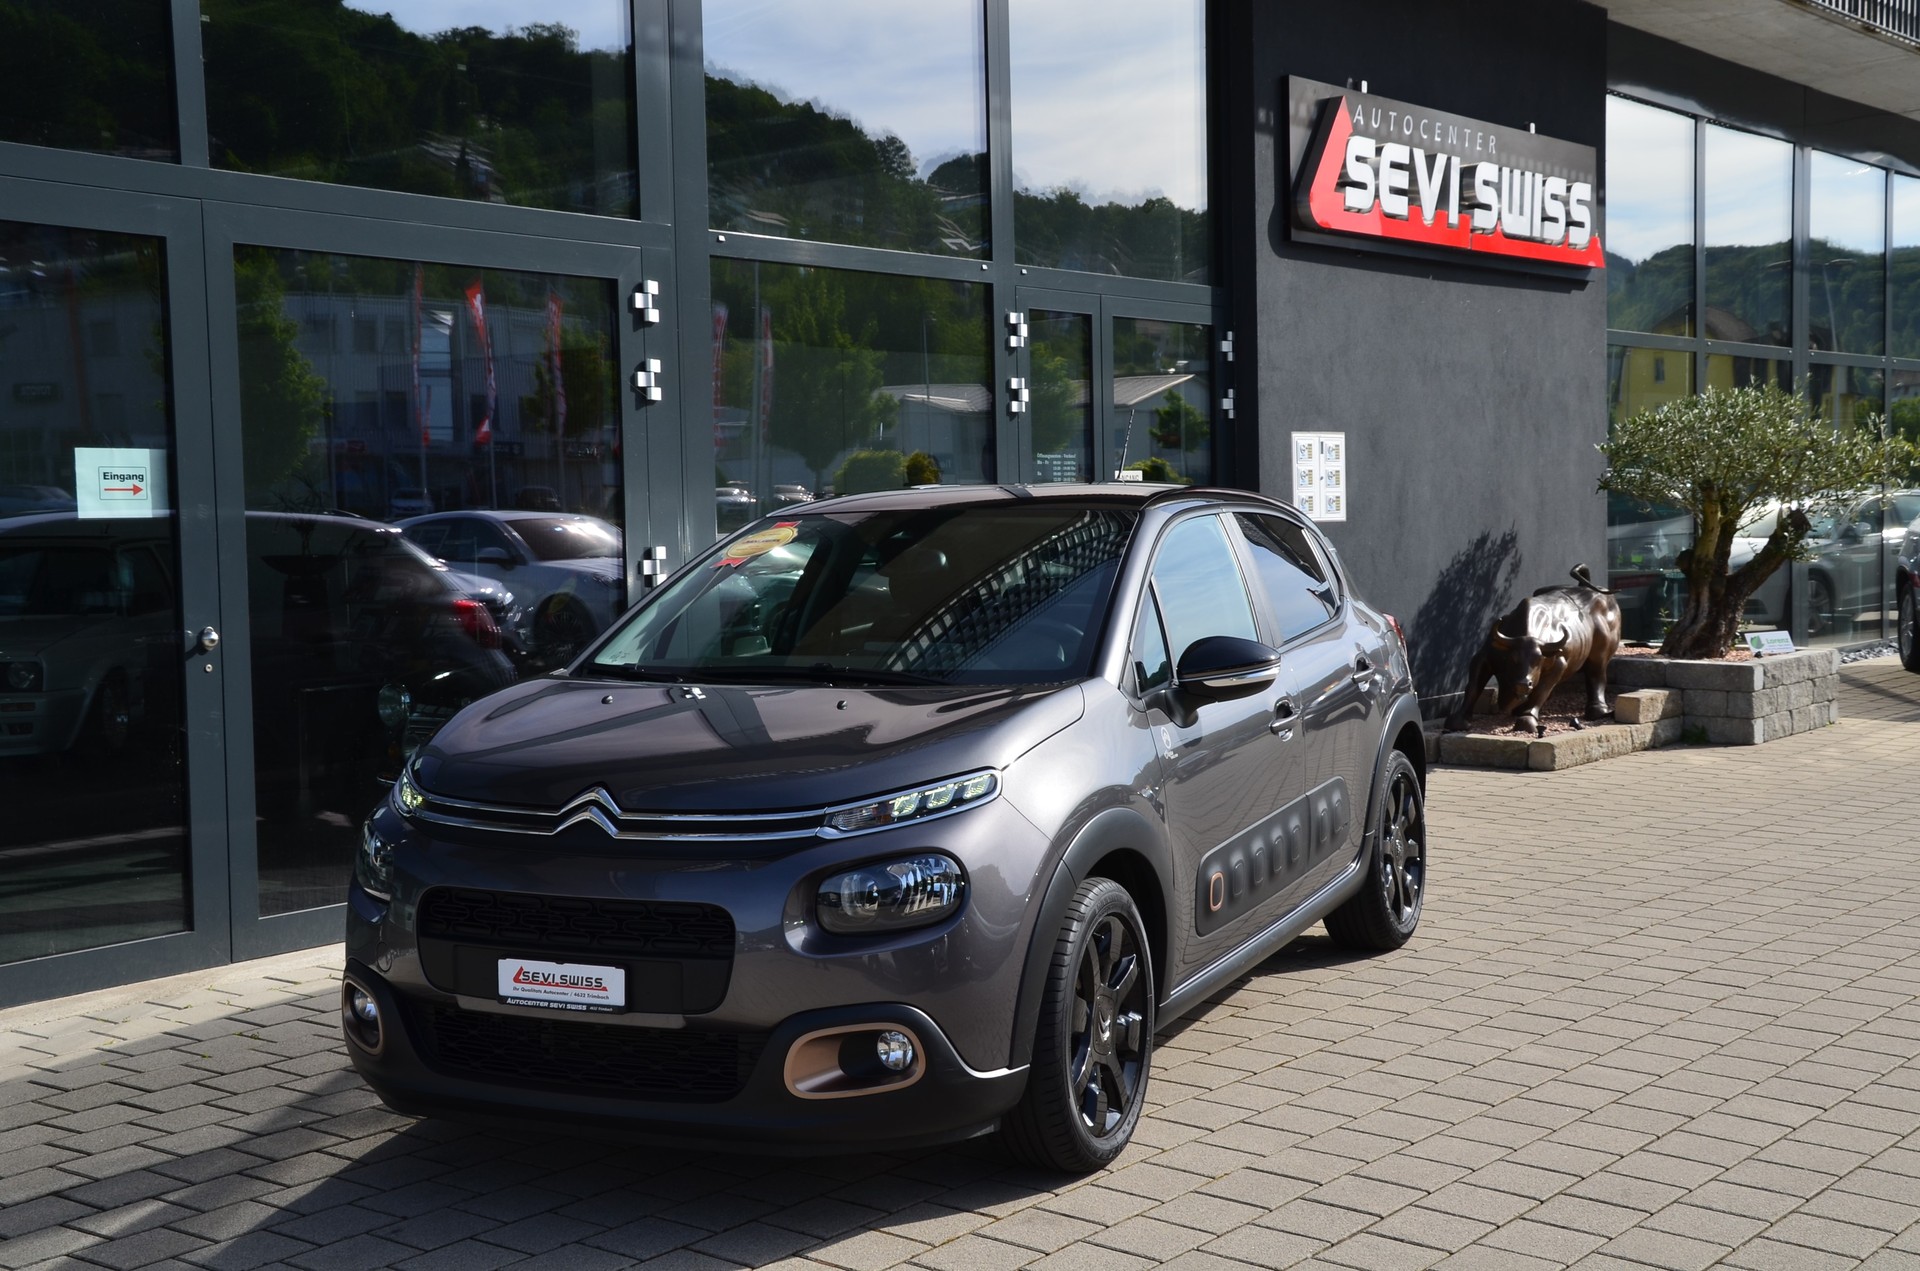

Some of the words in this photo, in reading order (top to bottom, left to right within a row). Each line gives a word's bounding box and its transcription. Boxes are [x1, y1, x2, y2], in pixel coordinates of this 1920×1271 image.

[1353, 104, 1497, 154] AUTOCENTER
[1344, 135, 1461, 227] SEVI
[1473, 161, 1592, 247] SWISS
[103, 471, 144, 482] Eingang
[521, 971, 556, 984] SEVI
[559, 974, 603, 988] SWISS
